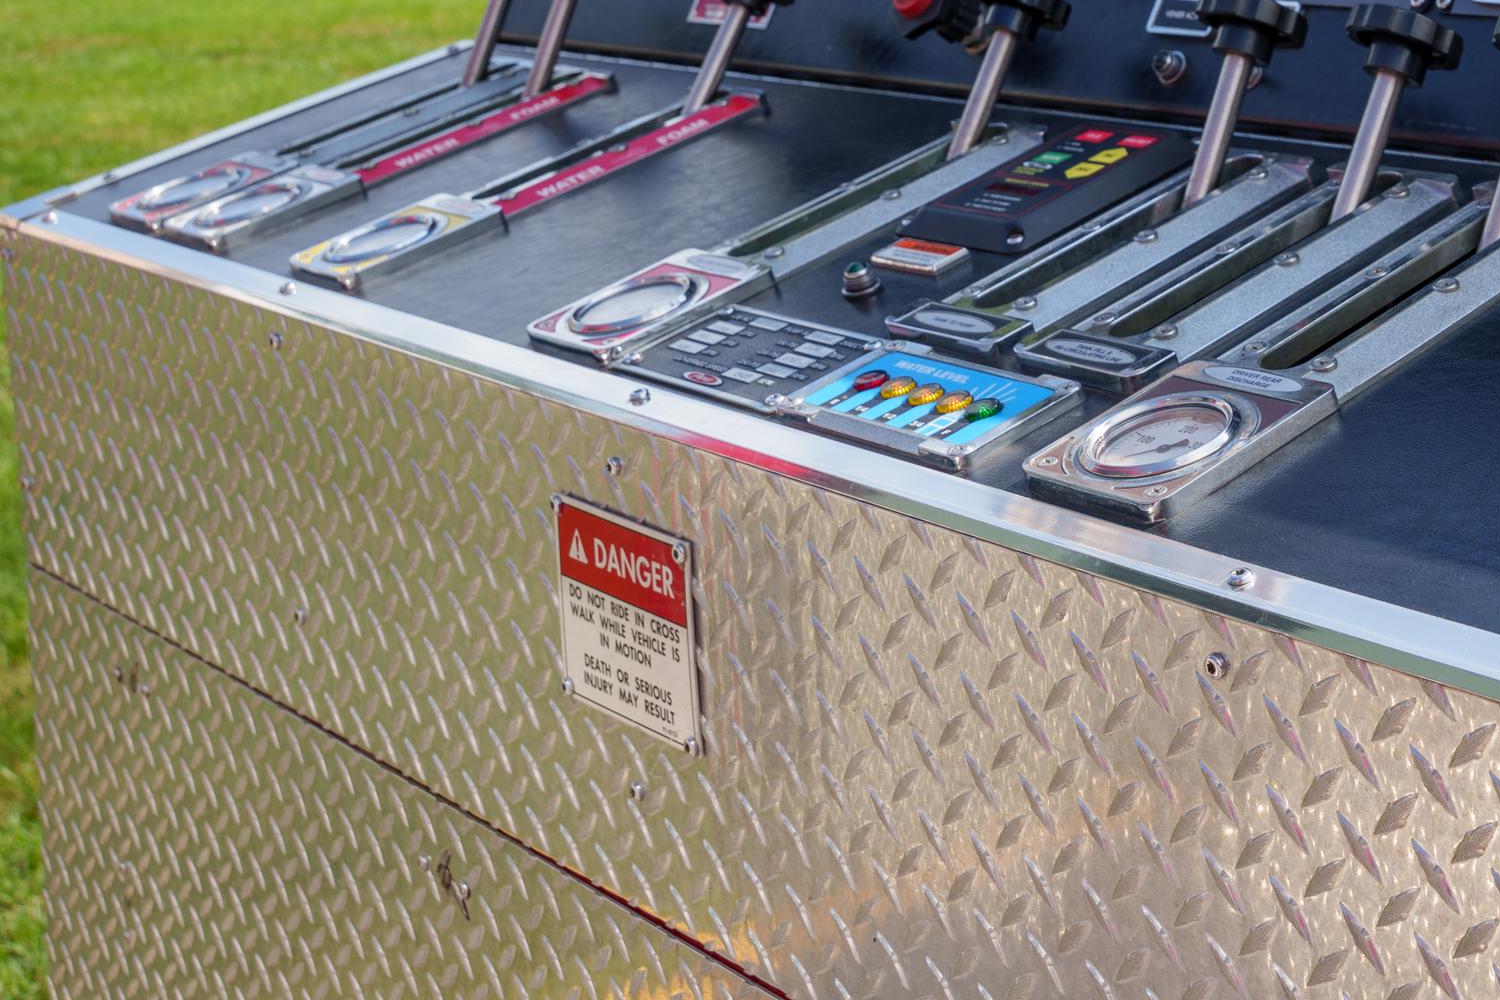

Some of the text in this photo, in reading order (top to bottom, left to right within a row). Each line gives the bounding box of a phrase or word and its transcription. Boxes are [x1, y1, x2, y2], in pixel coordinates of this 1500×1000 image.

[394, 96, 561, 169] WATER FOAM
[535, 118, 709, 199] WATER FOAM
[895, 361, 970, 383] WATER LEVEL
[1226, 375, 1271, 388] DISCHARGE
[1232, 369, 1282, 383] DRIVER REAR
[593, 537, 676, 599] DANGER
[569, 583, 680, 644] DO NOT RIDE IN CROSS
[570, 602, 681, 662] WALK WHILE VEHICLE IS
[600, 634, 652, 668] IN MOTION
[584, 653, 672, 706] DEATH OR SERIOUS
[584, 673, 675, 725] INJURY MAY RESULT
